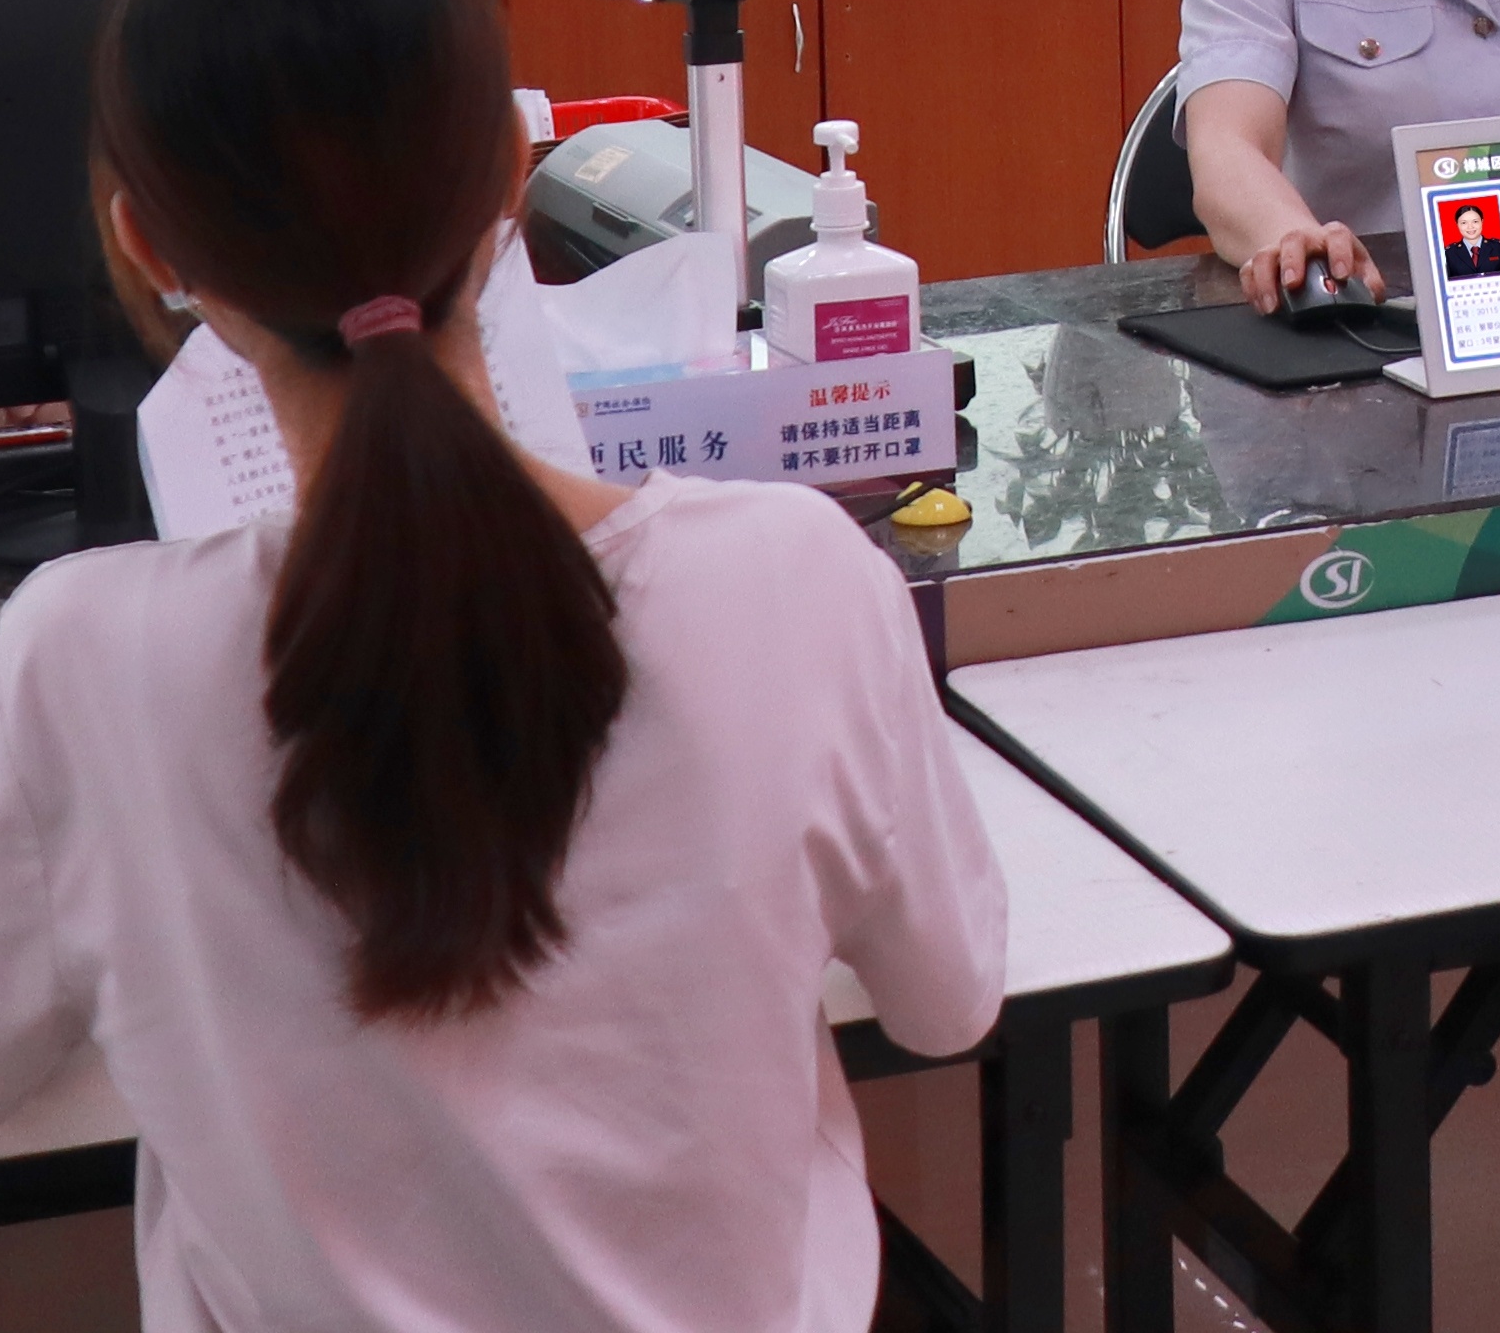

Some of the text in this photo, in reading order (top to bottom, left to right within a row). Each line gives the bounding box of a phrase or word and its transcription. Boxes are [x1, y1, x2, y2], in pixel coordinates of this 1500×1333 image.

[808, 379, 893, 408] 温馨提示
[780, 408, 921, 444] 请保持适当距离
[782, 436, 922, 472] 请不要打开口罩
